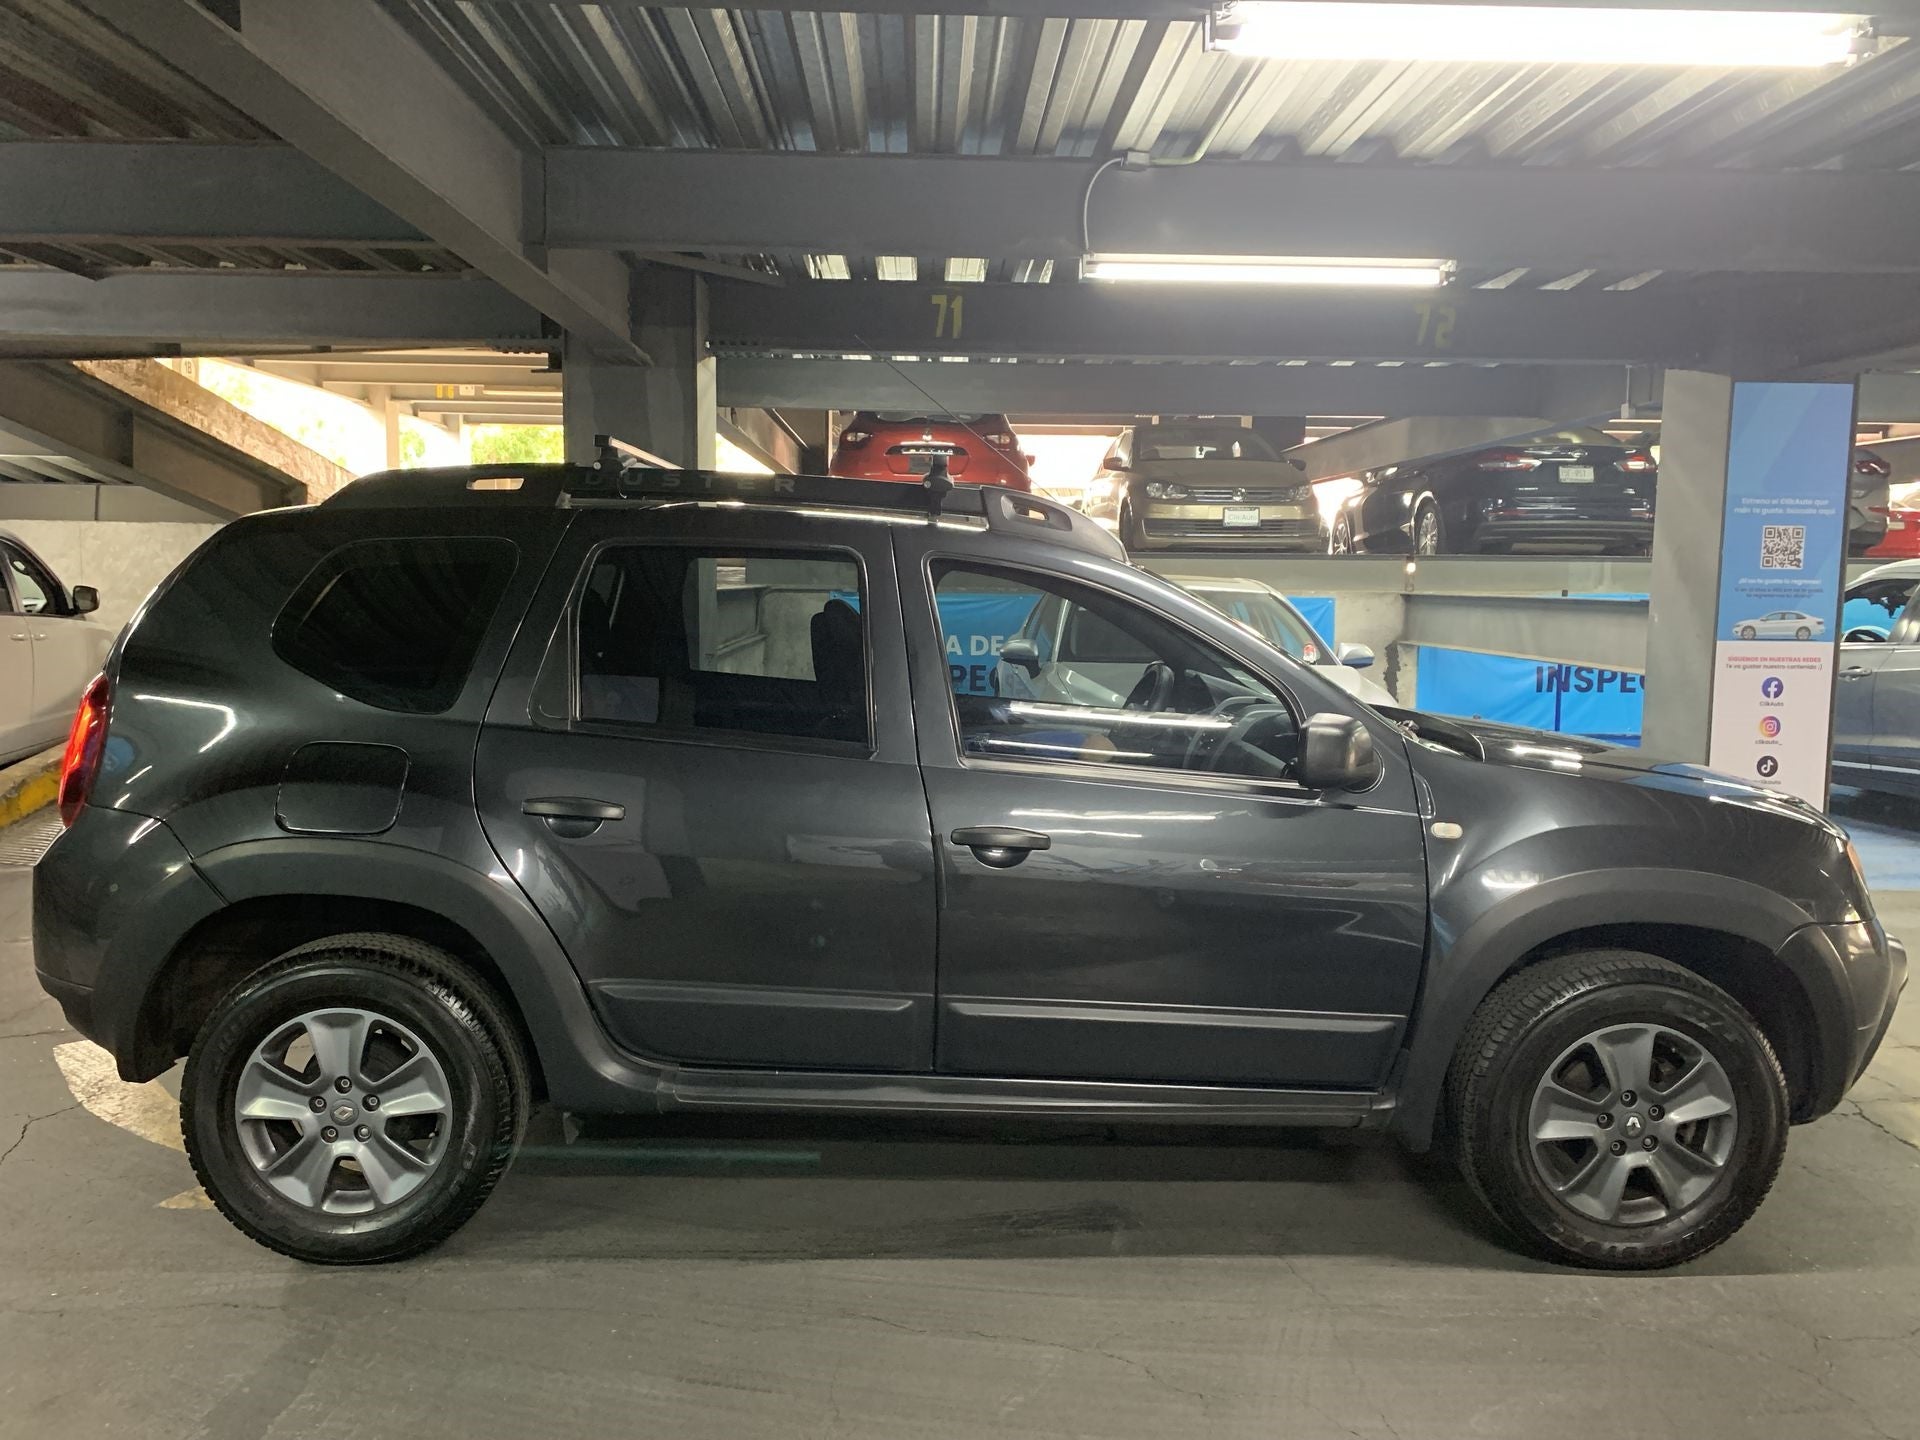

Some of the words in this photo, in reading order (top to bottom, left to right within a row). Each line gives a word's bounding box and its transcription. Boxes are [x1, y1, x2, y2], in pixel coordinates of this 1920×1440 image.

[931, 294, 963, 339] 71
[1412, 303, 1456, 348] 72
[970, 635, 1004, 656] DE
[1535, 664, 1646, 693] INSPE
